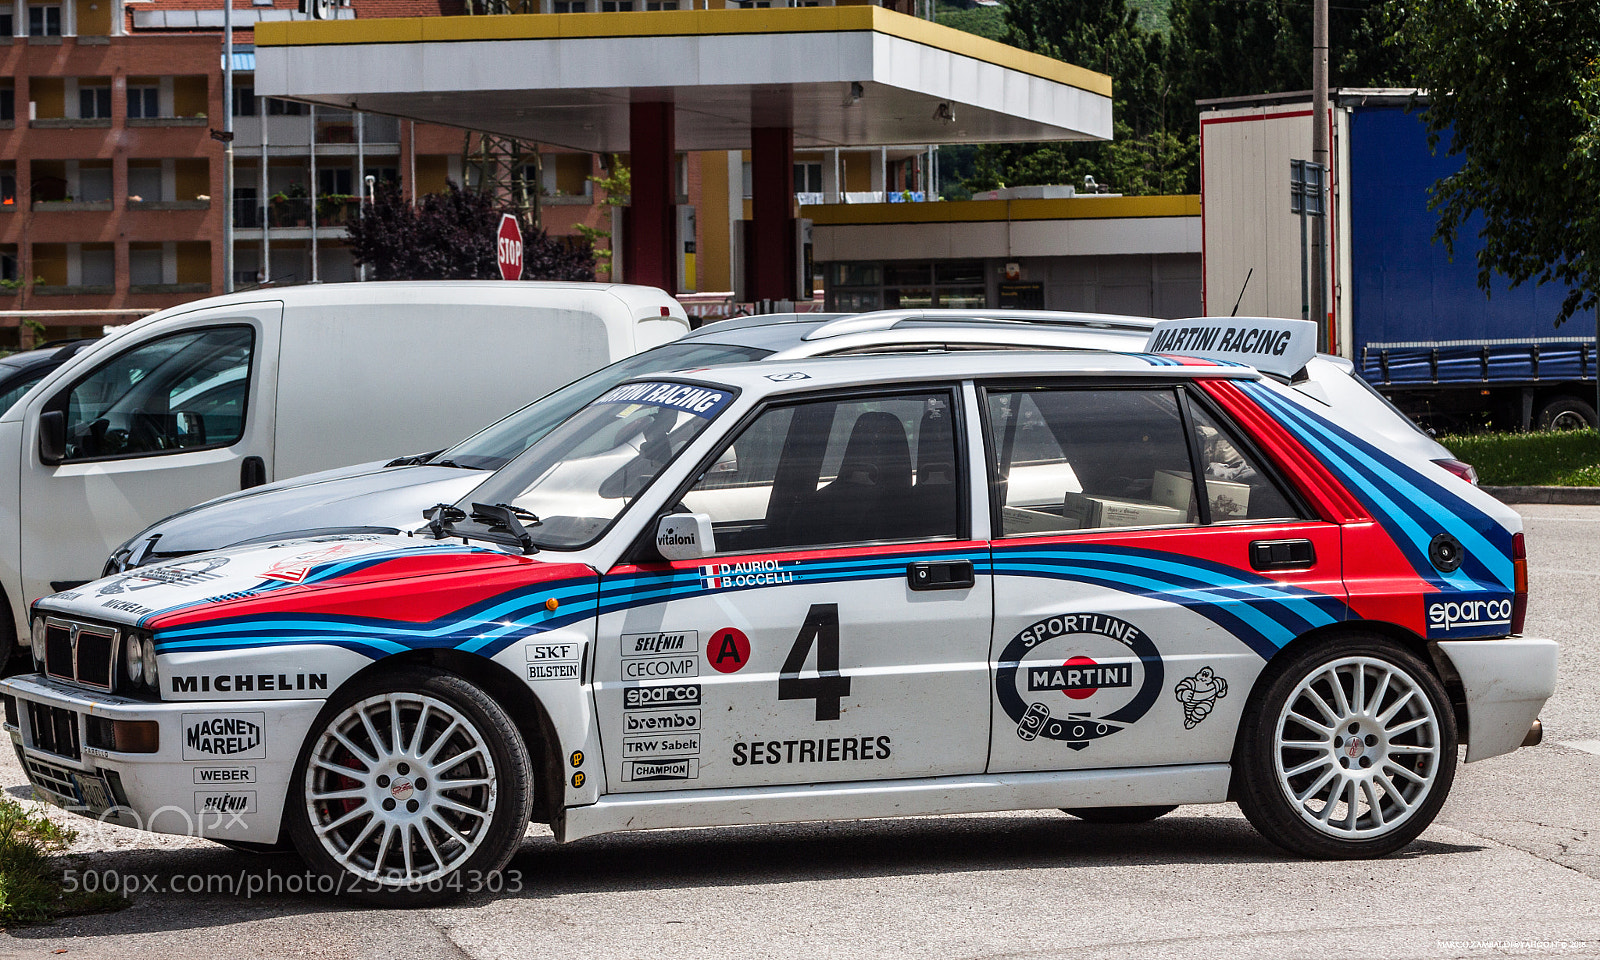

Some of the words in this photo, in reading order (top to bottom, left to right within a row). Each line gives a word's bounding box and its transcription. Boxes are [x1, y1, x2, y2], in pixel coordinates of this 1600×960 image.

[499, 237, 521, 266] STOP
[1150, 327, 1222, 353] MARTINI
[1217, 328, 1291, 357] RACING
[642, 384, 722, 413] RACING
[657, 532, 696, 546] vitaloni
[720, 559, 784, 575] D.AURIOL
[722, 571, 794, 588] B.OCCELLI
[1428, 598, 1512, 631] sparco
[1020, 614, 1140, 648] SPORTLINE
[534, 645, 571, 659] SKF
[716, 633, 741, 664] A
[529, 664, 578, 678] BILSTEIN
[626, 660, 693, 677] CECOMP
[778, 602, 851, 722] 4
[172, 673, 328, 693] MICHELIN
[1032, 667, 1129, 688] MARTINI
[626, 686, 699, 707] sparco
[627, 714, 697, 730] brembo
[187, 718, 260, 751] MAGNETI
[626, 741, 659, 753] TRW
[661, 740, 698, 751] Sabelt
[732, 735, 892, 767] SESTRIERES
[200, 769, 250, 781] WEBER
[636, 765, 686, 775] CHAMPION
